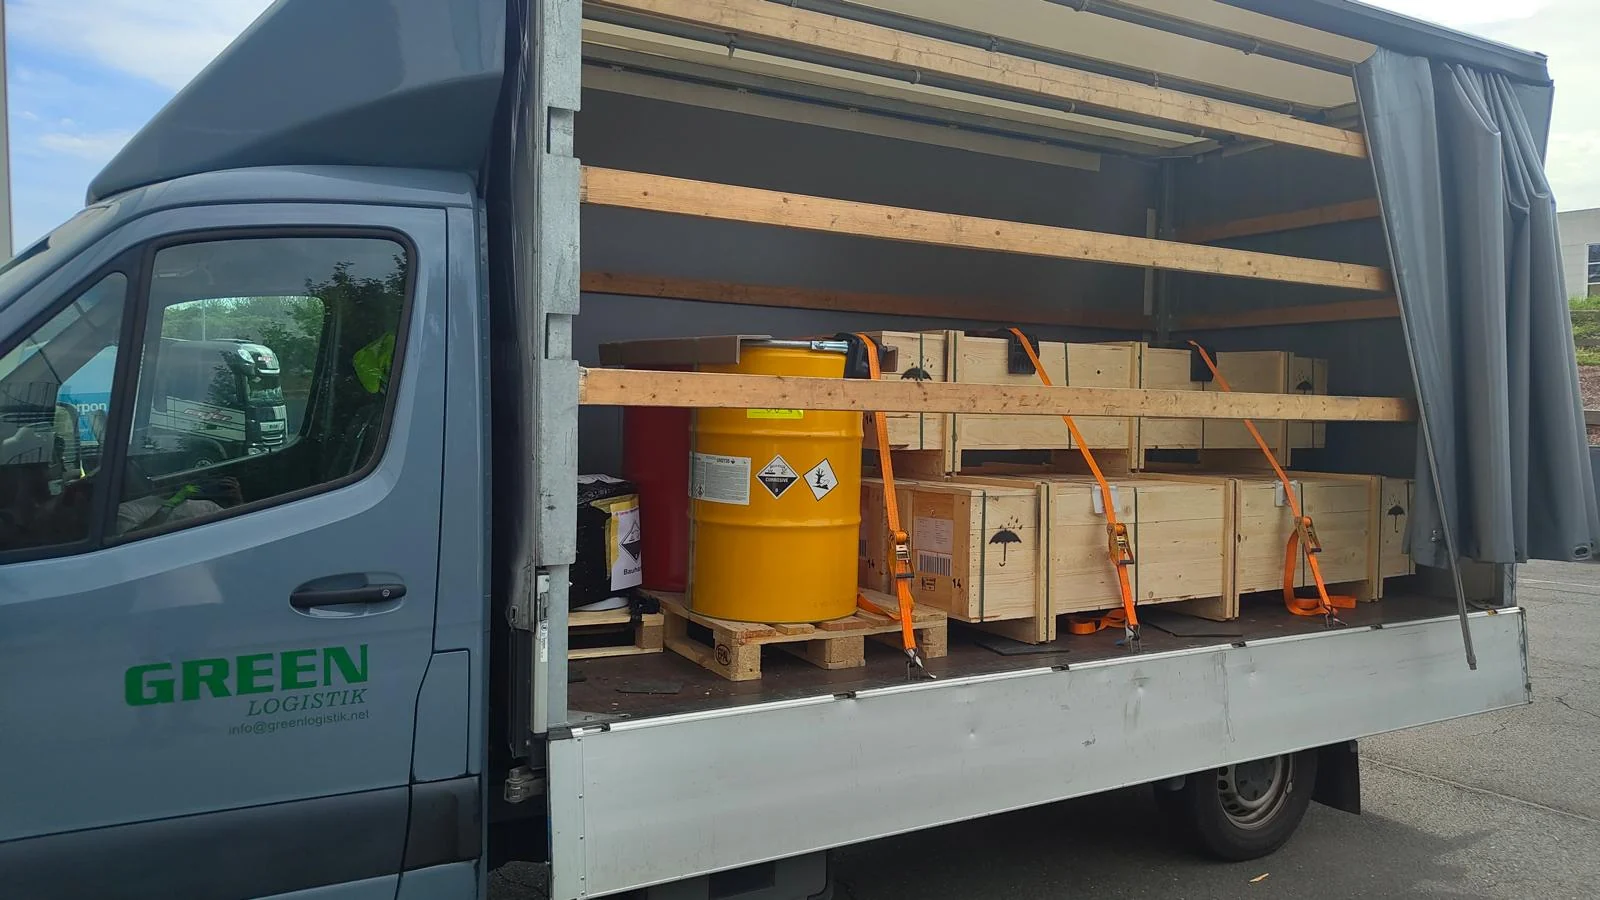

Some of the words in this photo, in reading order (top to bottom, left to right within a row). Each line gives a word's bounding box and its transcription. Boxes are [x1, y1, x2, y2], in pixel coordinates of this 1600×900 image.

[867, 558, 875, 568] 14
[952, 578, 961, 588] 14
[125, 644, 369, 707] GREEN
[246, 688, 368, 717] LOGISTIK
[228, 709, 369, 736] info@greenlogistik.net
